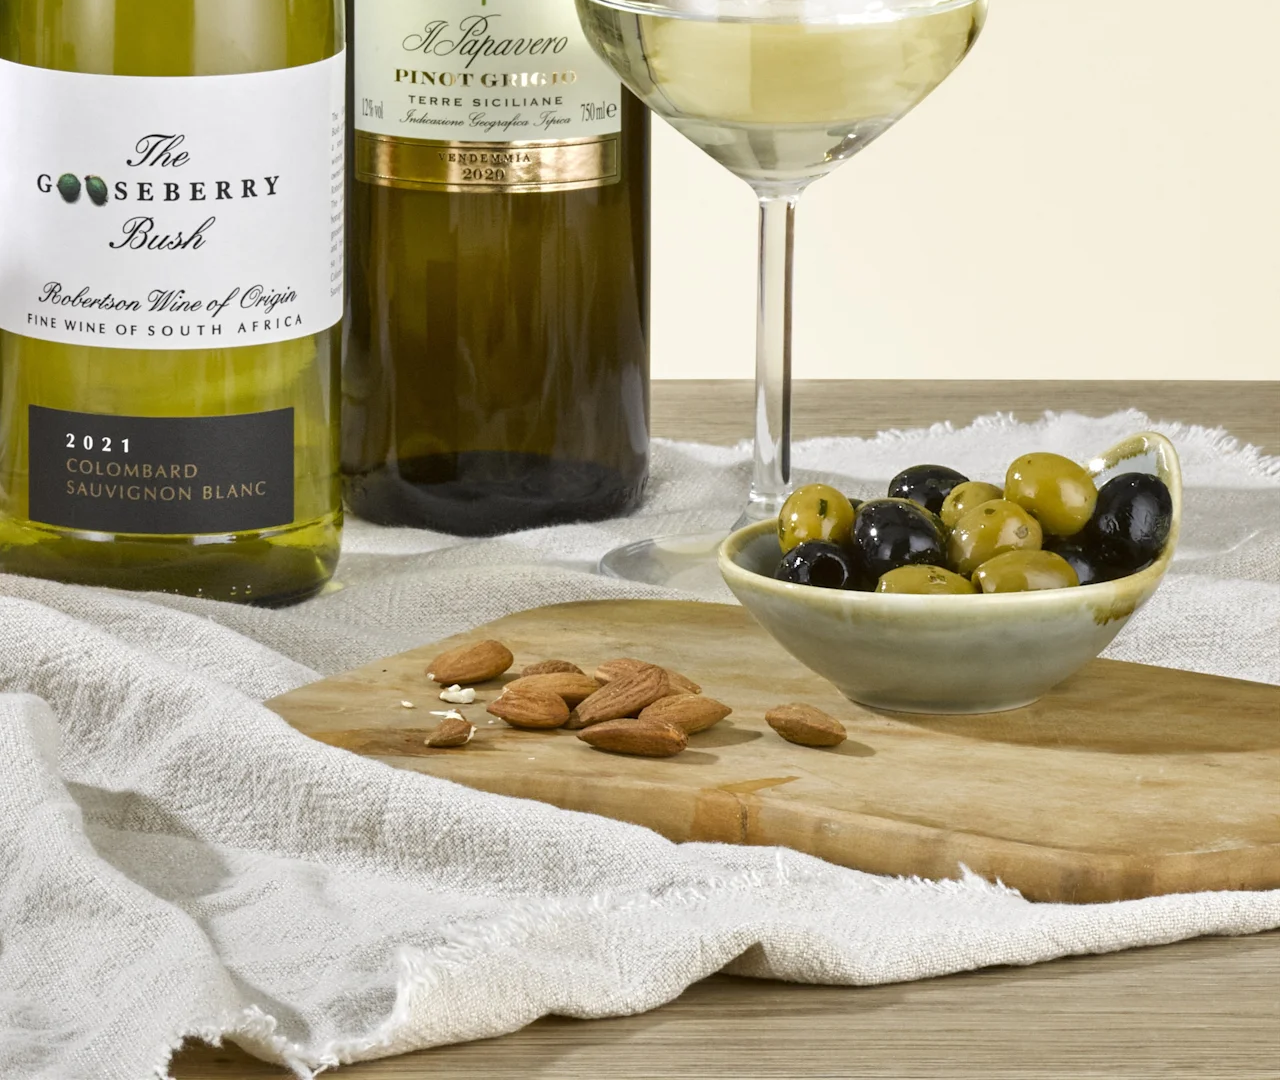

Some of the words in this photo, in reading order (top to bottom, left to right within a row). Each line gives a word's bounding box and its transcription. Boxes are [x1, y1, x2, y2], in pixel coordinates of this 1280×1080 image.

[434, 14, 569, 69] Papavero
[394, 68, 474, 88] PINOT
[480, 70, 578, 89] GRIGIO
[407, 94, 463, 107] TERRE
[472, 96, 563, 108] SICILIANE
[399, 108, 465, 127] Indicazione
[468, 111, 530, 134] Geografica
[533, 110, 572, 131] Tipica
[126, 133, 191, 168] The
[438, 153, 531, 164] VENDEMMIA
[462, 168, 506, 182] 2020
[108, 216, 216, 251] Bush
[38, 281, 142, 313] Robertson
[146, 288, 203, 313] Wine
[206, 287, 241, 318] of
[239, 284, 298, 315] Origin
[27, 314, 58, 330] FINE
[65, 319, 106, 335] WINE
[115, 324, 138, 337] OF
[148, 324, 223, 337] SOUTH
[237, 314, 303, 334] AFRICA
[65, 432, 130, 453] 2021
[66, 458, 198, 479] COLOMBARD
[66, 480, 192, 501] SAUVIGNON
[202, 481, 267, 500] BLANC
